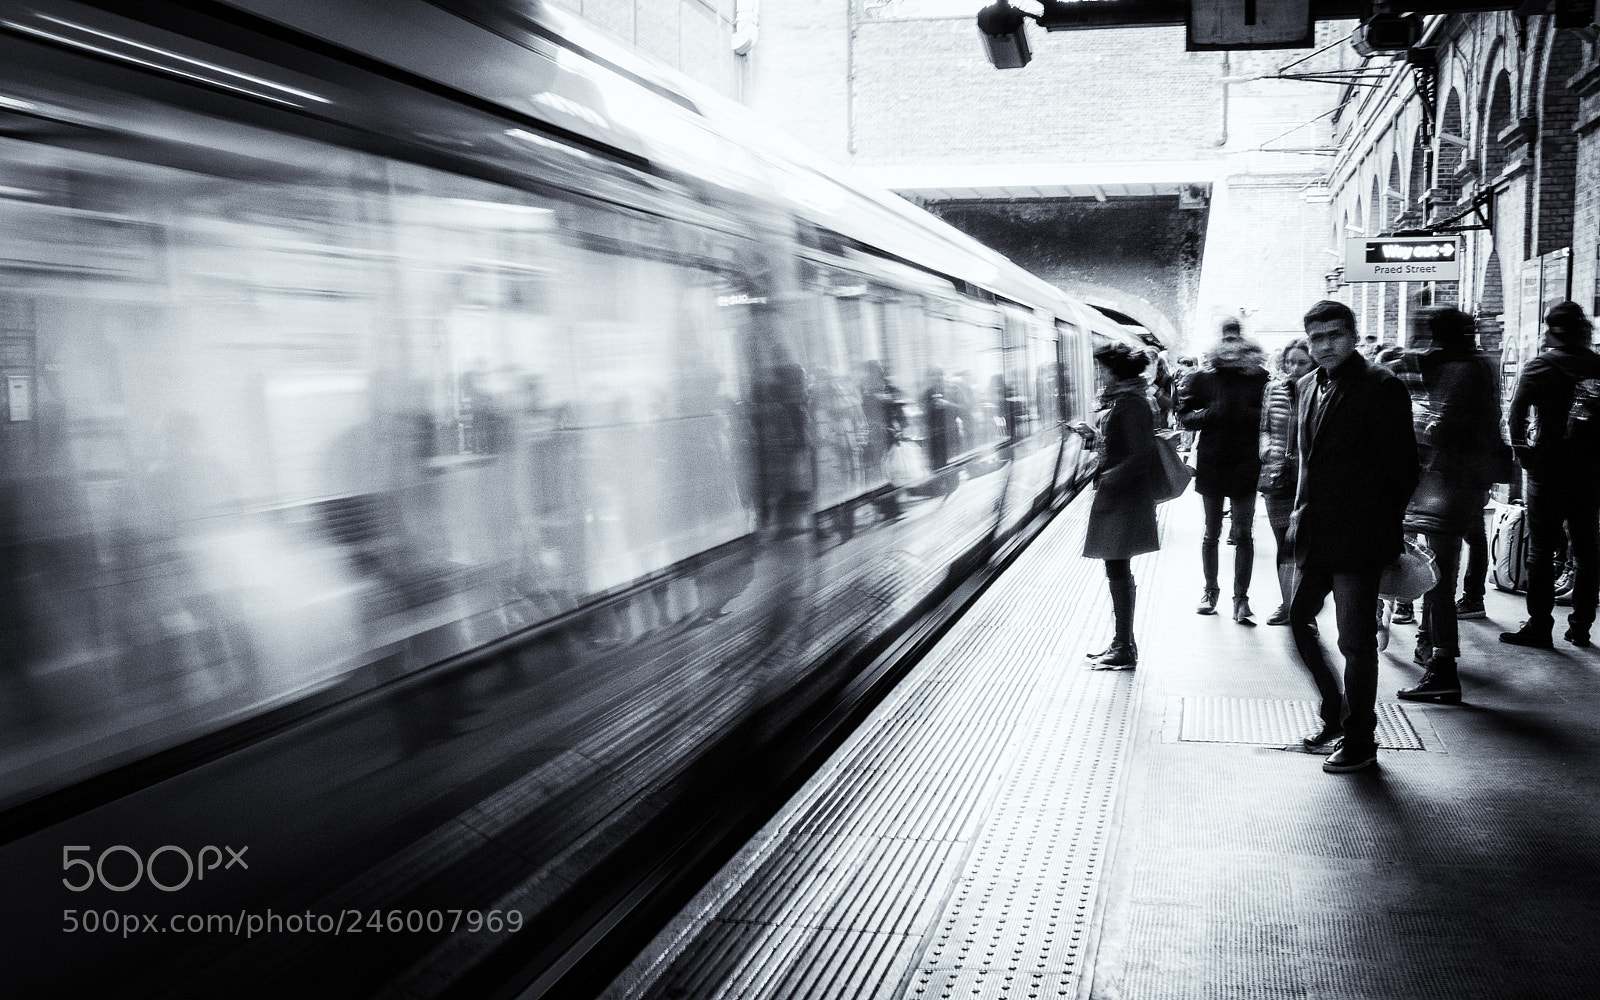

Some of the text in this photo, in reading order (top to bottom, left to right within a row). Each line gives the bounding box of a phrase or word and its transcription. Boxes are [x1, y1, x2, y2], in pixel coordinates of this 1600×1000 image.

[1382, 244, 1440, 260] Way out
[1374, 265, 1437, 274] Praed Street
